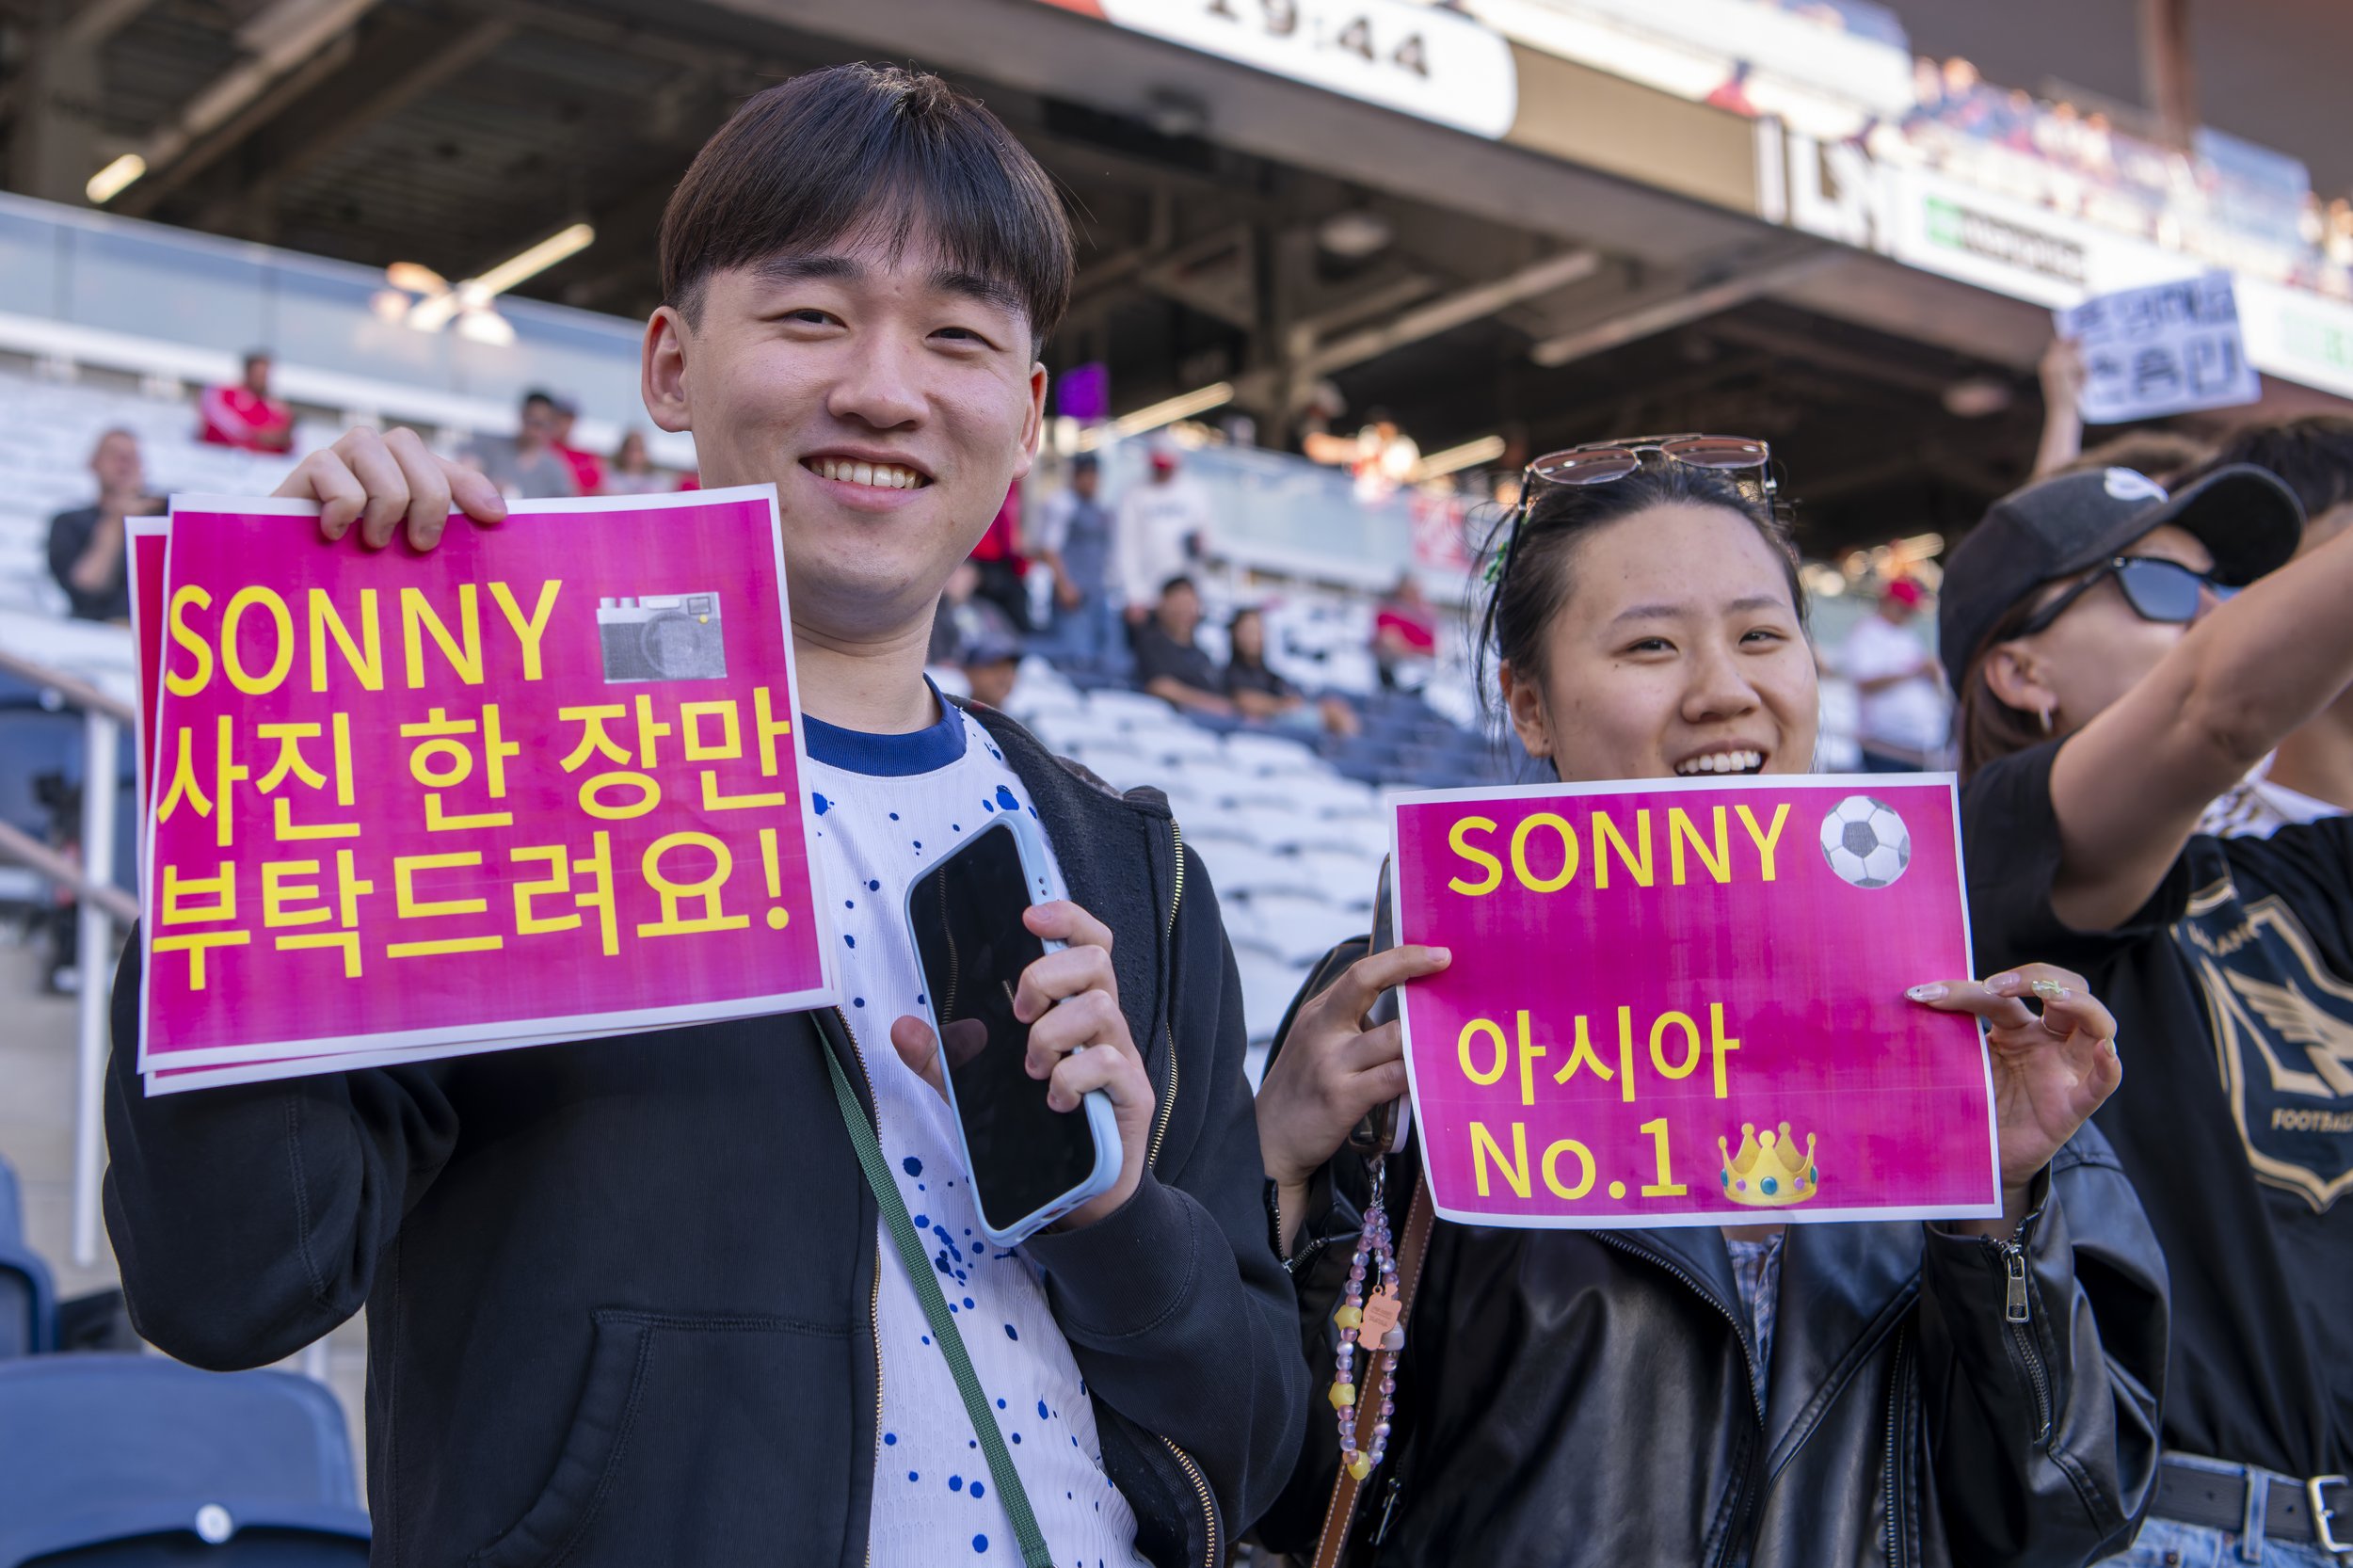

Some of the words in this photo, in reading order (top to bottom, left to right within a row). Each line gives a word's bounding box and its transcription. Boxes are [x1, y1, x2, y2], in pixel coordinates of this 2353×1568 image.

[165, 579, 563, 697] SONNY
[156, 712, 361, 847] 사진
[399, 703, 520, 832] 한
[558, 686, 792, 821] 장만
[1447, 803, 1791, 897] SONNY
[152, 828, 791, 991] 부탁드려요!
[1456, 1001, 1741, 1106] 아시아
[1469, 1117, 1688, 1200] No.1
